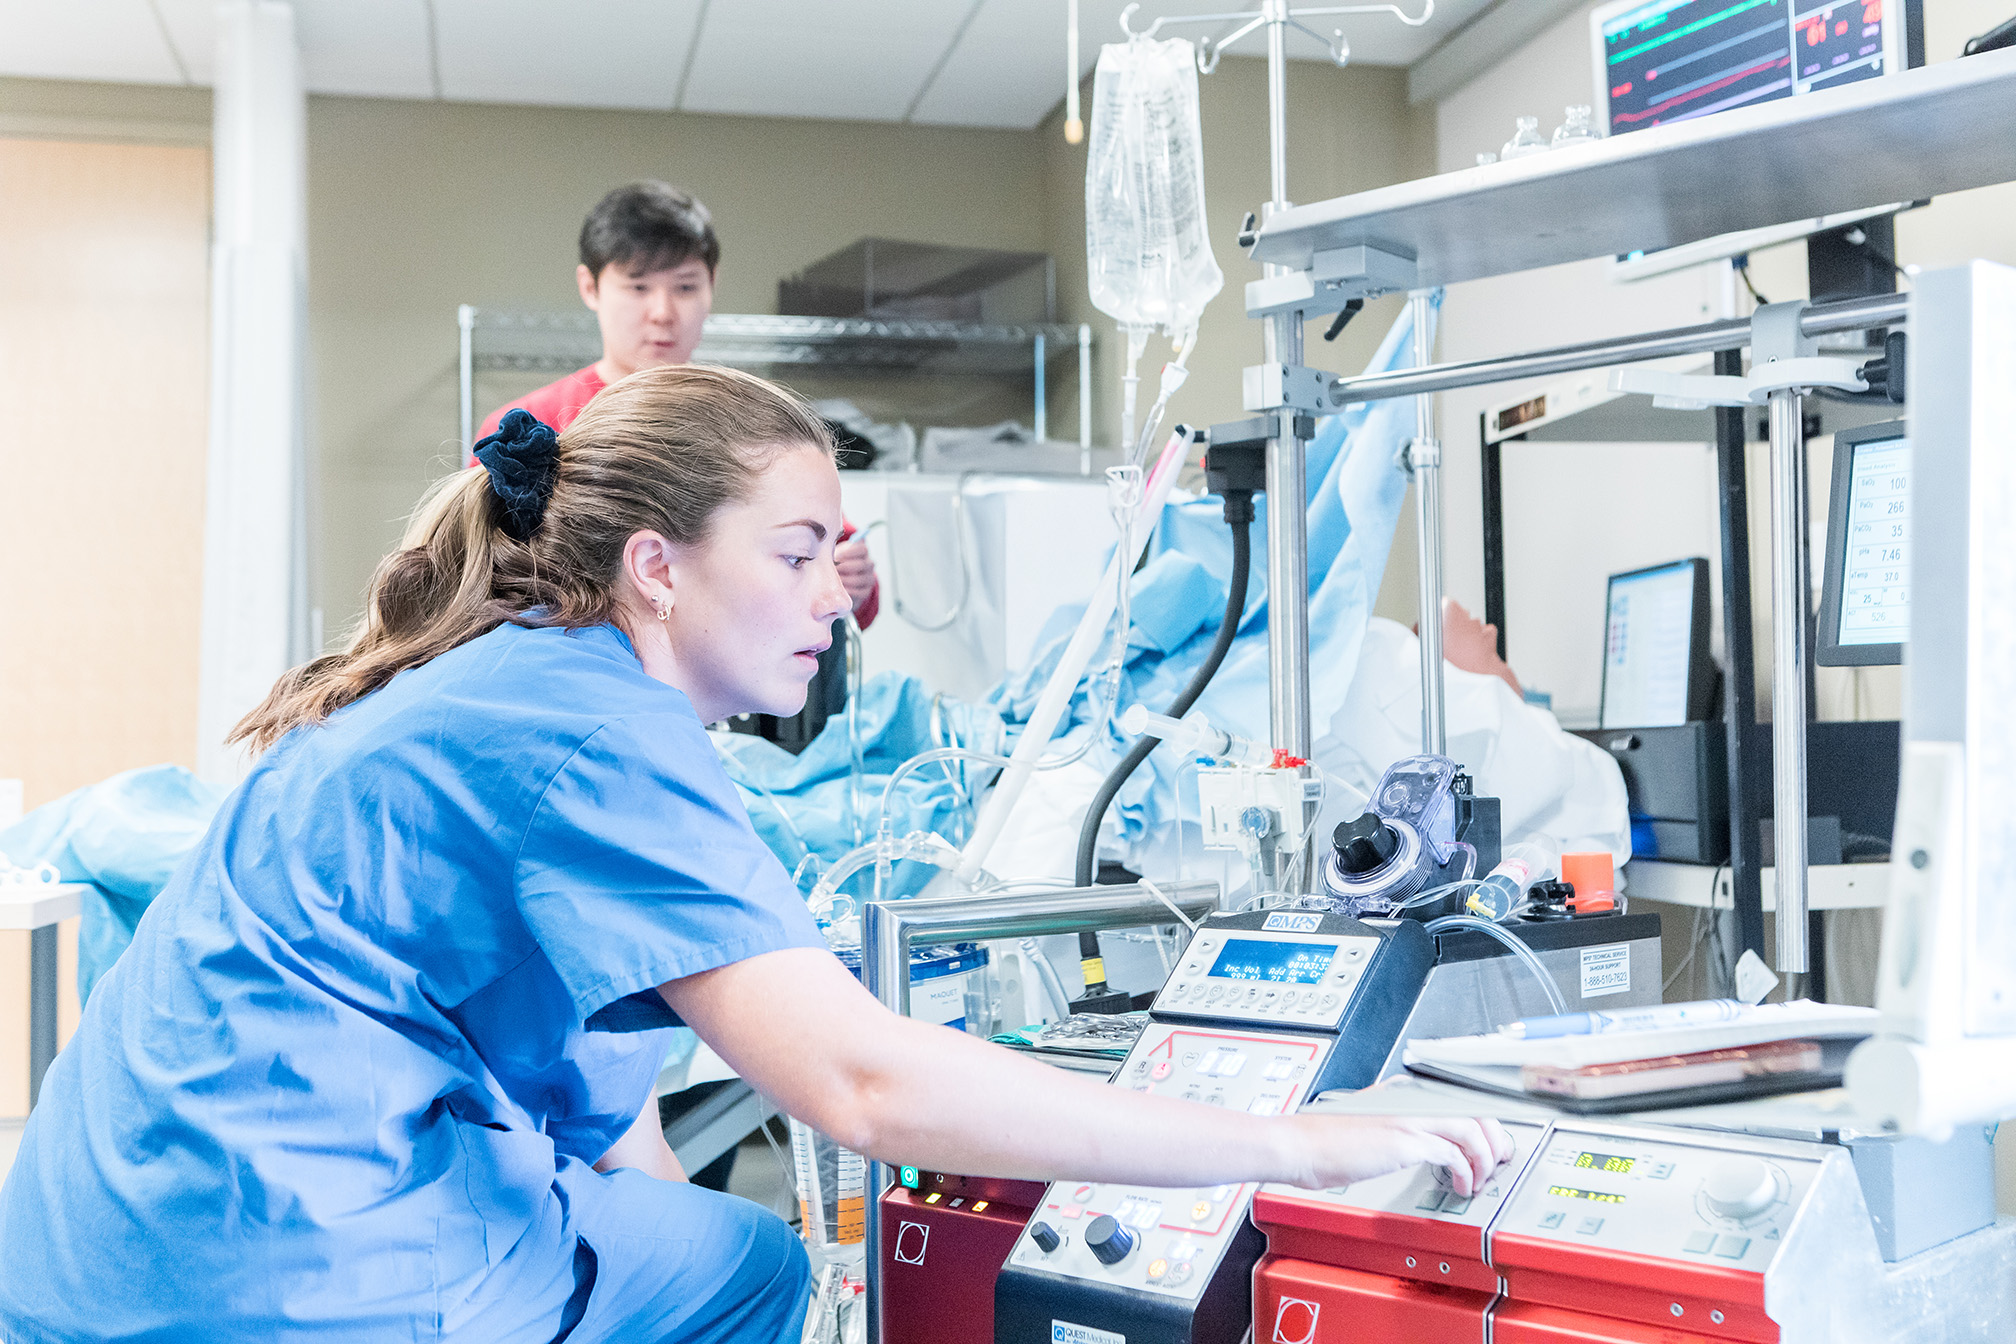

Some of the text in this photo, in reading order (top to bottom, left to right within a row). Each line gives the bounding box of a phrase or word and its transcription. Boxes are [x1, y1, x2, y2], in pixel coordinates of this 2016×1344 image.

[1890, 477, 1906, 490] 100
[1887, 501, 1905, 514] 266
[1891, 524, 1903, 538] 35
[1881, 548, 1901, 561] 7.46
[1863, 594, 1872, 603] 25
[1871, 612, 1886, 622] 526
[1297, 953, 1308, 962] On
[1593, 952, 1611, 960] TECHNICAL
[1224, 964, 1240, 973] Inc
[1244, 966, 1260, 974] Vol
[1268, 967, 1287, 976] Add
[1289, 969, 1306, 978] Arr
[1605, 961, 1621, 969] SUPPORT
[1584, 971, 1627, 987] 1-888-510-7623
[930, 988, 958, 1000] MAQUET
[1066, 1328, 1086, 1340] QUEST
